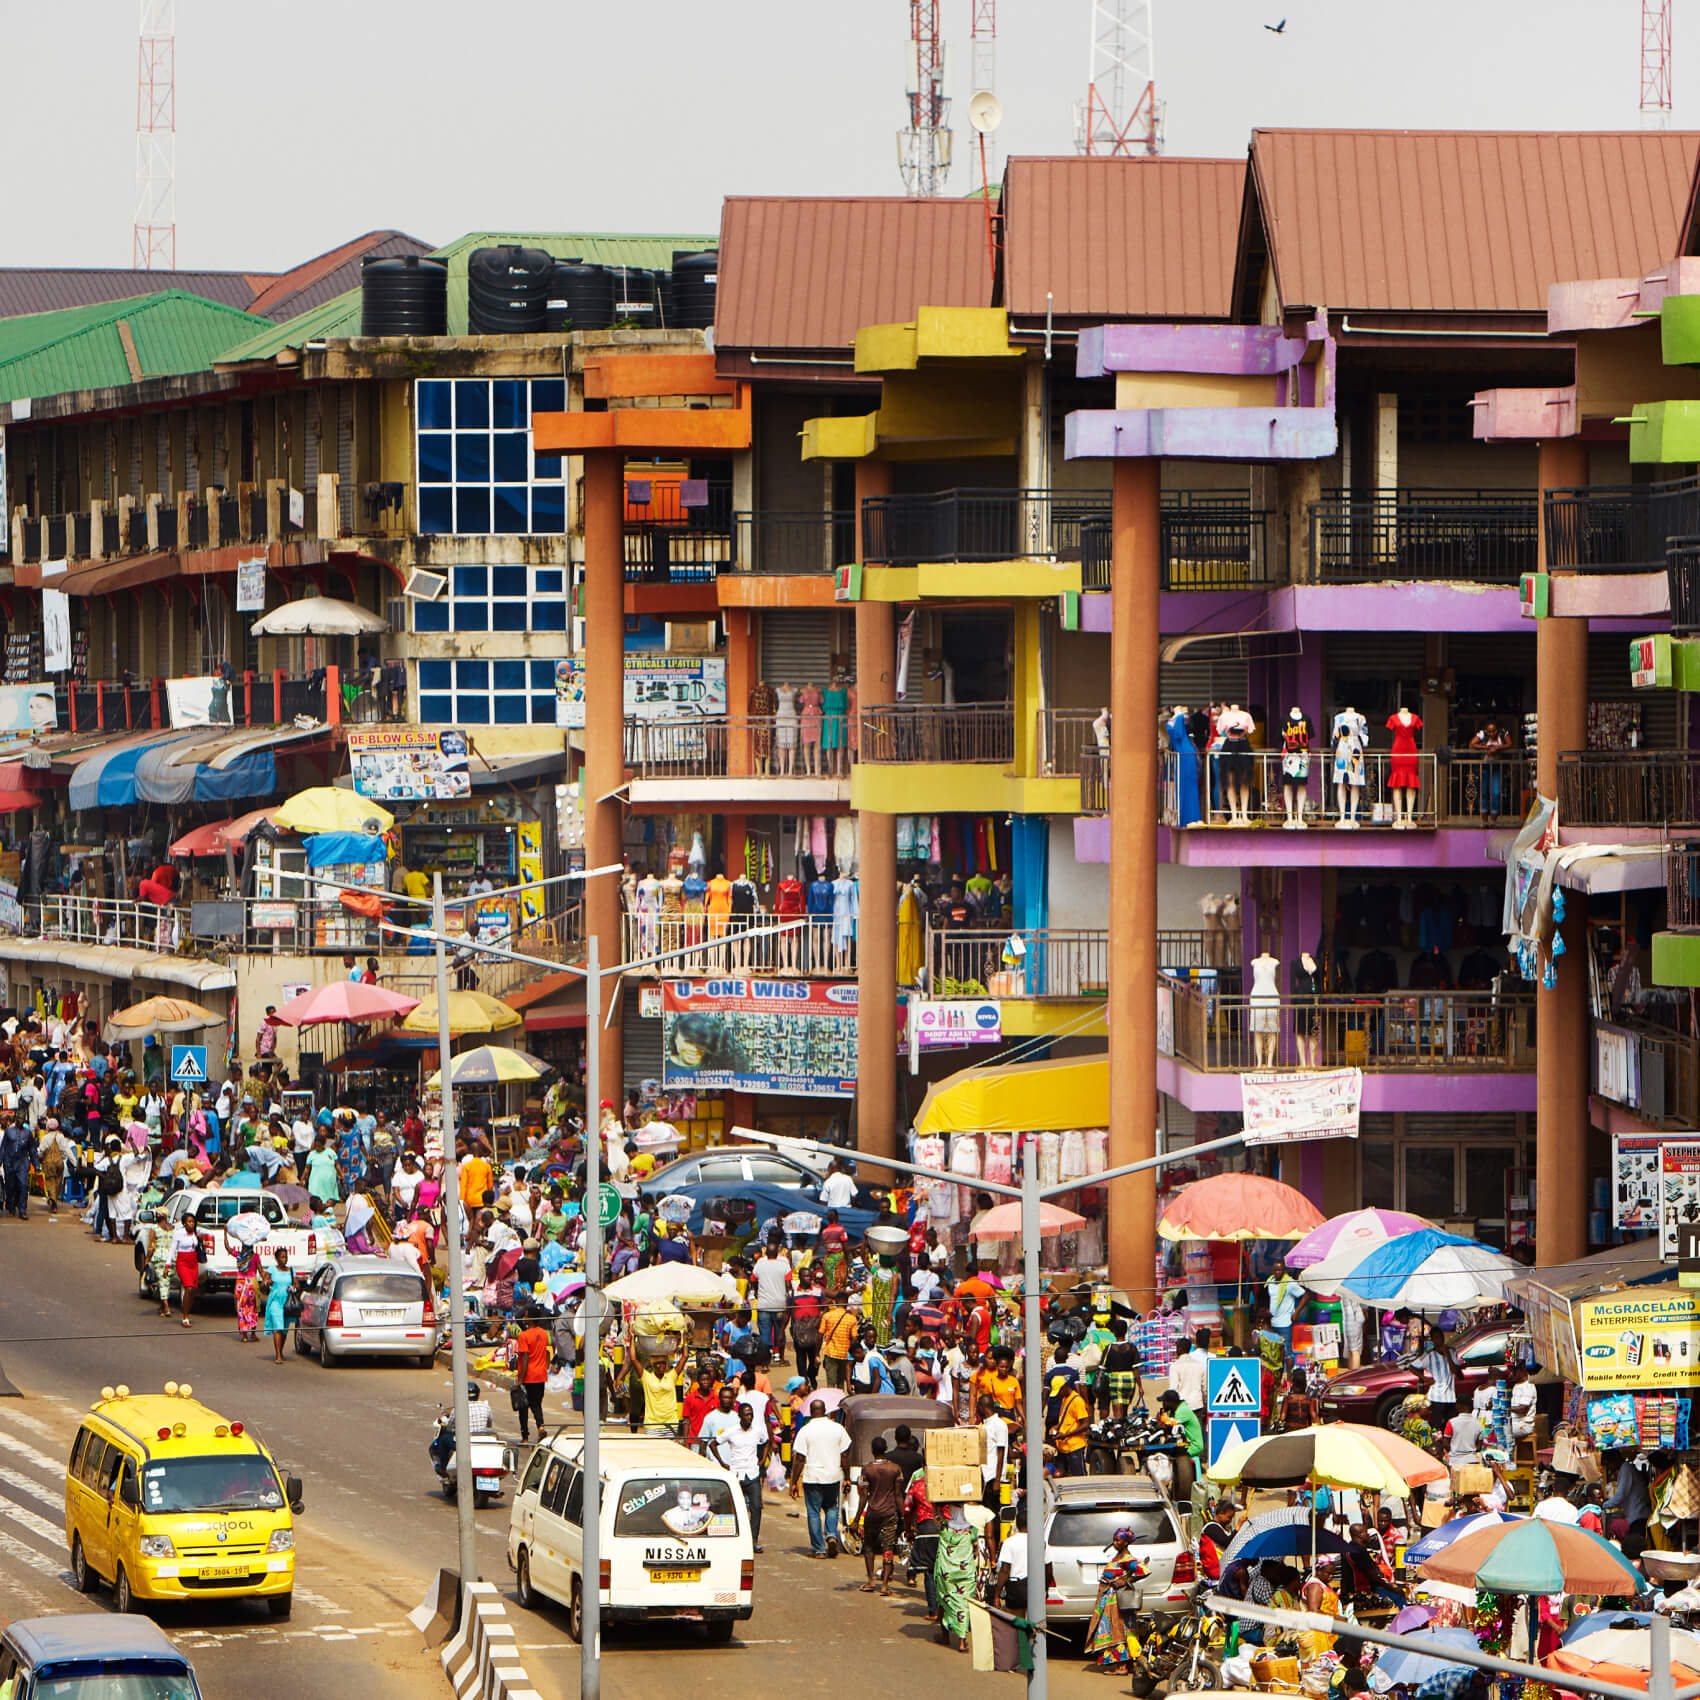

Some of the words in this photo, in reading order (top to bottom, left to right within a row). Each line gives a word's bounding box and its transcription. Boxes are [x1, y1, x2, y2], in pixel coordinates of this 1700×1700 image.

[350, 735, 365, 745] DE
[368, 734, 401, 744] BLOW
[405, 732, 437, 743] G.S.M
[675, 980, 746, 998] U-ONE
[752, 981, 810, 1000] WIGS
[977, 1013, 997, 1021] NIVEA
[227, 1245, 296, 1257] MIUBIHI
[1594, 1301, 1696, 1315] McGRACELAND
[1590, 1315, 1649, 1326] ENTERPRISE
[1589, 1347, 1611, 1357] MTN
[1615, 1373, 1641, 1382] Money
[1653, 1371, 1678, 1379] Credit
[622, 1495, 646, 1514] City
[644, 1483, 667, 1502] Boy
[645, 1548, 706, 1560] NISSAN
